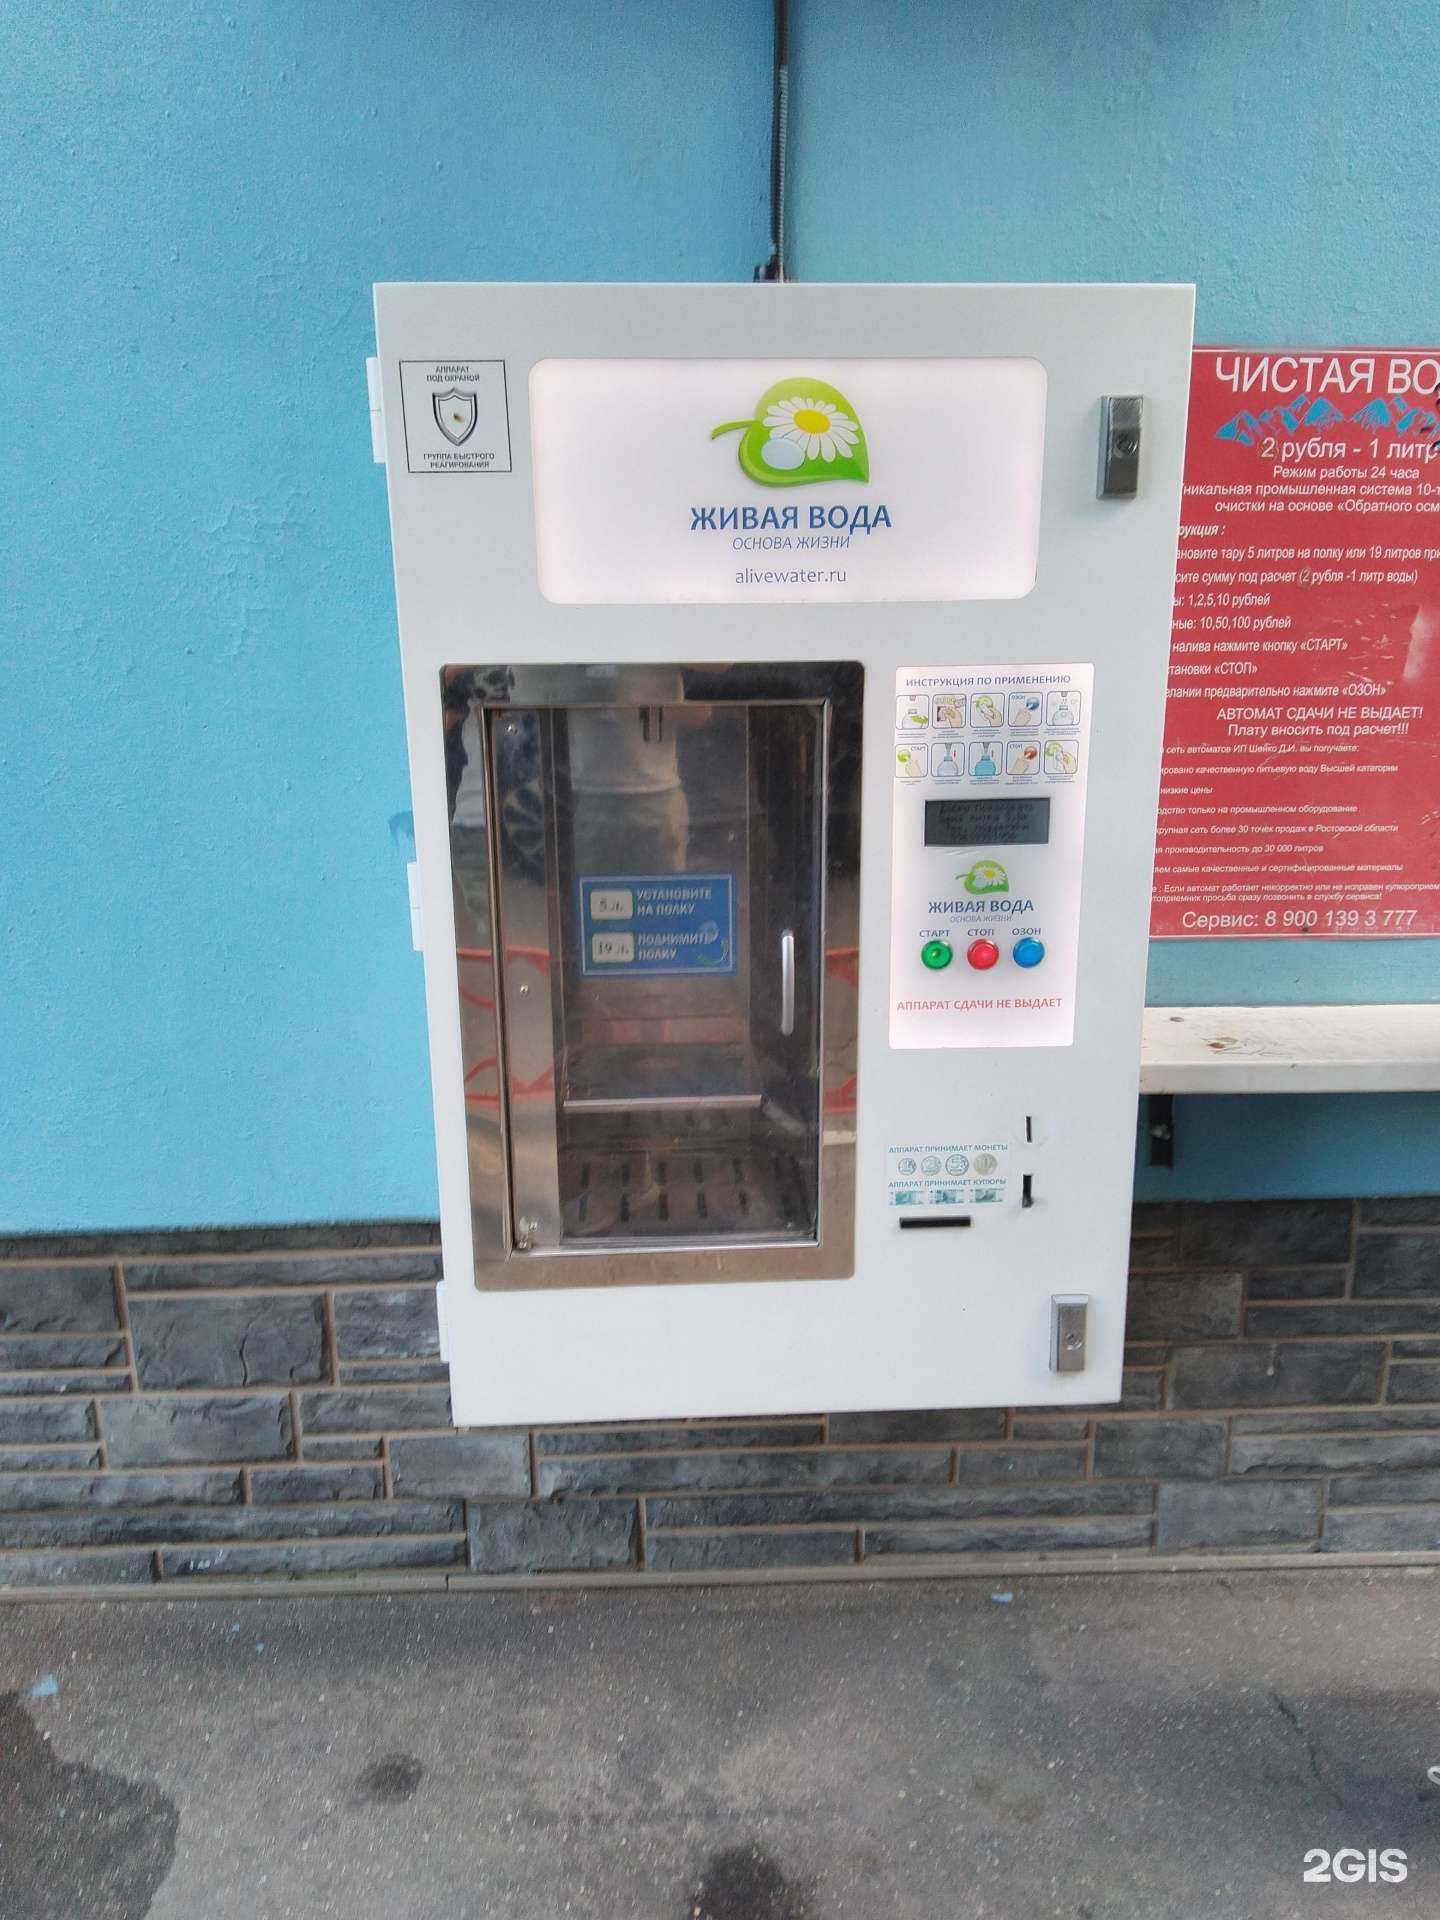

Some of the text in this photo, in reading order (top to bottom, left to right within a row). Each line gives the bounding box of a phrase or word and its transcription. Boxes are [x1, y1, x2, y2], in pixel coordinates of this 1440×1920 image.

[435, 365, 470, 373] АППАРАТ
[1215, 356, 1376, 393] ЧИСТАЯ
[426, 374, 480, 383] ПОД ОХРАНОЙ
[453, 452, 495, 460] БЫСТРОГО
[1260, 437, 1276, 458] 2
[1281, 436, 1346, 464] рубля
[1369, 437, 1379, 459] 1
[430, 461, 490, 469] РЕАГИРОВАНИЯ
[1273, 465, 1420, 480] Режим работы 24 часа
[1182, 483, 1412, 497] никальная промышленная система
[1214, 501, 1265, 512] очистки
[1269, 501, 1285, 512] на
[1288, 501, 1334, 512] основе
[1338, 498, 1413, 514] «Обратного
[690, 504, 892, 535] ЖИВАЯ ВОДА
[732, 535, 850, 550] ОСНОВА ЖИЗНИ
[1221, 548, 1245, 561] тару
[1247, 546, 1255, 558] 5
[1257, 548, 1295, 561] литров
[1297, 548, 1311, 559] на
[1313, 547, 1344, 562] полку
[1346, 547, 1366, 559] или
[1369, 545, 1382, 558] 19
[1384, 547, 1421, 562] литров
[735, 568, 848, 584] alivewater.ru
[1202, 571, 1235, 585] сумму
[1238, 571, 1258, 584] под
[1260, 571, 1297, 584] расчет
[1299, 568, 1312, 585] (2
[1312, 569, 1345, 585] рубля
[1359, 571, 1385, 584] литр
[1387, 569, 1419, 584] воды)
[1188, 593, 1230, 607] 1,2,5,10
[1232, 592, 1271, 608] рублей
[1200, 615, 1292, 631] 10,50,100 рублей
[1172, 638, 1349, 654] налива нажмите кнопку «СТАРТ»
[1214, 661, 1258, 675] «СТОП»
[906, 675, 1071, 688] ИНСТРУКЦИЯ ПО ПРИМЕНЕНИЮ
[1204, 686, 1291, 700] предварительно
[1293, 686, 1339, 697] нажмите
[1342, 682, 1387, 697] «ОЗОН»
[1216, 706, 1424, 721] АВТОМАТ СДАЧИ НЕ ВЫДАЕТ!
[1228, 722, 1410, 738] Плату вносить под расчет!!!
[1166, 746, 1185, 754] сеть
[1187, 745, 1231, 754] автоматов
[1233, 743, 1248, 753] ИП
[1300, 744, 1311, 753] вы
[1195, 765, 1255, 776] качественную
[1256, 765, 1297, 775] питьевую
[1299, 764, 1319, 775] воду
[1320, 763, 1355, 773] Высшей
[1190, 786, 1213, 795] цены
[1188, 806, 1216, 815] только
[1218, 806, 1228, 814] на
[1230, 805, 1296, 815] промышленном
[1190, 826, 1208, 834] сеть
[1210, 824, 1237, 834] более
[1238, 824, 1249, 834] 30
[1364, 823, 1399, 833] области
[1165, 846, 1250, 856] производительность
[1251, 846, 1263, 854] до
[1294, 844, 1324, 853] литров
[1172, 865, 1200, 873] самые
[1201, 864, 1260, 873] качественные
[636, 887, 712, 900] УСТАНОВИТЕ
[1164, 884, 1185, 893] Если
[1187, 885, 1220, 893] автомат
[1222, 883, 1259, 893] работает
[1315, 883, 1331, 891] или
[1202, 892, 1236, 902] просьба
[1238, 893, 1262, 902] сразу
[1314, 891, 1344, 901] службу
[637, 903, 695, 915] НА ПОЛКУ
[928, 899, 1034, 914] ЖИВАЯ ВОДА
[950, 914, 1012, 923] ОСНОВА ЖИЗНИ
[1182, 909, 1418, 931] Сервис: 8 900 139 3 777
[919, 929, 950, 938] СТАРТ
[967, 928, 995, 936] СТОП
[1012, 927, 1041, 936] ОЗОН
[638, 948, 677, 960] ПОЛКУ
[896, 998, 1063, 1011] АППАРАТ СДАЧИ НЕ ВЫДАЕТ
[925, 1144, 972, 1152] ПРИНИМАЕТ
[974, 1143, 1008, 1151] МОНЕТЫ
[888, 1180, 923, 1188] АППАРАТ
